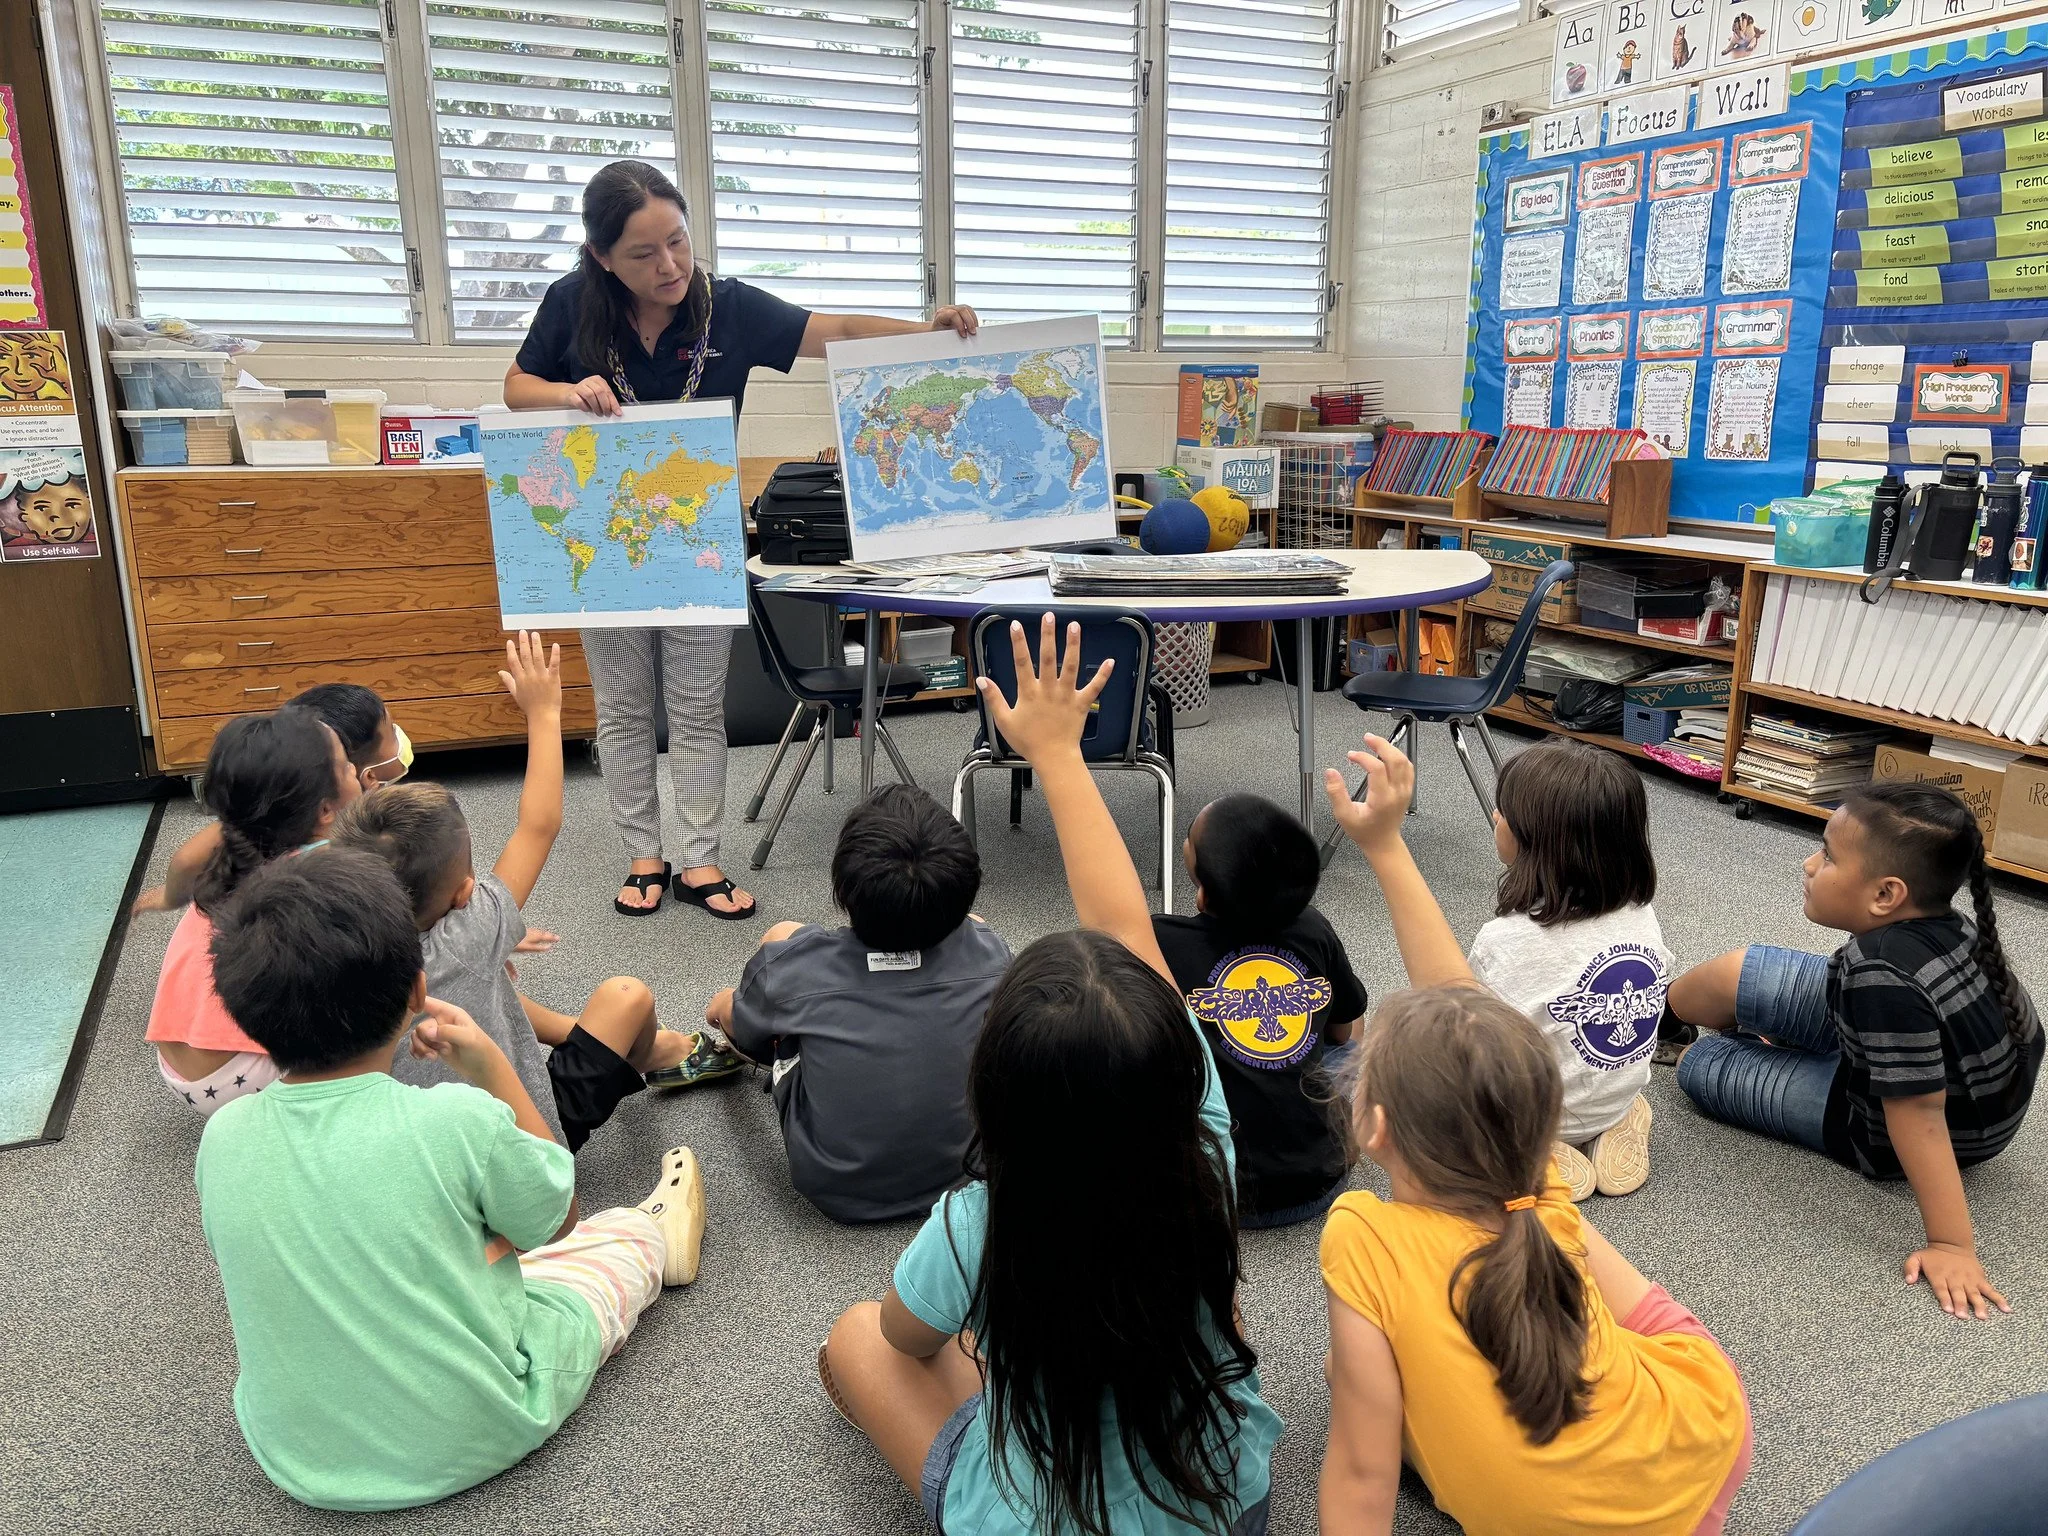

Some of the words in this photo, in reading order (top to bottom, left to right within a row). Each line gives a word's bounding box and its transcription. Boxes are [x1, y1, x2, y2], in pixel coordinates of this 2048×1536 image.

[1618, 2, 1645, 33] Bb
[1563, 20, 1593, 48] Aa
[1956, 81, 2029, 104] Vocabulary
[1544, 116, 1584, 152] ELA
[1616, 105, 1678, 136] Focus
[1716, 77, 1770, 115] Wall
[1972, 106, 2013, 121] Words
[1743, 144, 1797, 160] Comprehension
[1891, 150, 1933, 164] believe
[2017, 152, 2035, 161] things
[1661, 156, 1708, 171] Comprehension
[1762, 155, 1774, 165] Skill
[1592, 167, 1626, 182] Essential
[1669, 167, 1698, 178] Strategy
[1902, 171, 1927, 179] something
[1592, 176, 1626, 191] Question
[1521, 197, 1533, 208] Big
[1534, 194, 1553, 206] Idea
[1761, 198, 1787, 206] Problem
[1884, 190, 1934, 205] delicious
[1662, 207, 1705, 221] Predictions
[1755, 208, 1781, 218] Solution
[1610, 219, 1622, 227] can
[1885, 233, 1916, 247] feast
[1898, 256, 1912, 264] very
[1523, 270, 1535, 278] part
[1884, 272, 1908, 286] fond
[2016, 285, 2033, 294] things
[1870, 295, 1891, 303] enjoying
[1896, 294, 1912, 303] great
[1650, 321, 1695, 334] Vocabulary
[1726, 321, 1777, 335] Grammar
[1518, 334, 1544, 346] Genre
[1579, 330, 1615, 344] Phonics
[1652, 333, 1689, 345] Strategy
[1850, 359, 1884, 375] change
[1578, 372, 1595, 381] Short
[1597, 373, 1614, 383] Long
[1654, 372, 1678, 383] Suffixes
[1745, 382, 1768, 390] Nouns
[1926, 383, 1944, 393] High
[1946, 383, 1994, 394] Frequency
[1846, 397, 1874, 409] cheer
[1945, 393, 1973, 402] Words
[18, 403, 63, 412] Attention
[390, 433, 419, 442] BASE
[480, 433, 496, 441] Map
[497, 432, 506, 440] Of
[522, 430, 543, 438] World
[1846, 435, 1860, 447] fall
[391, 442, 420, 452] TEN
[1939, 440, 1961, 451] look
[1226, 462, 1271, 479] MAUNA
[1237, 478, 1258, 491] LOA
[1876, 518, 1894, 567] Columbia
[22, 548, 40, 557] Use
[42, 546, 80, 555] Self-talk
[1495, 550, 1505, 560] 30
[1810, 580, 1817, 588] 3
[1684, 683, 1698, 693] 30
[1884, 754, 1892, 773] 6
[1963, 786, 1992, 806] Ready
[1985, 820, 1994, 833] 2
[1207, 951, 1237, 985] PRINCE
[1239, 944, 1276, 955] JONAH
[1576, 952, 1607, 989] PRINCE
[1608, 943, 1641, 956] JONAH
[1220, 1038, 1287, 1070] ELEMENTARY
[1289, 1032, 1319, 1064] SCHOOL
[1570, 1037, 1628, 1071] ELEMENTARY
